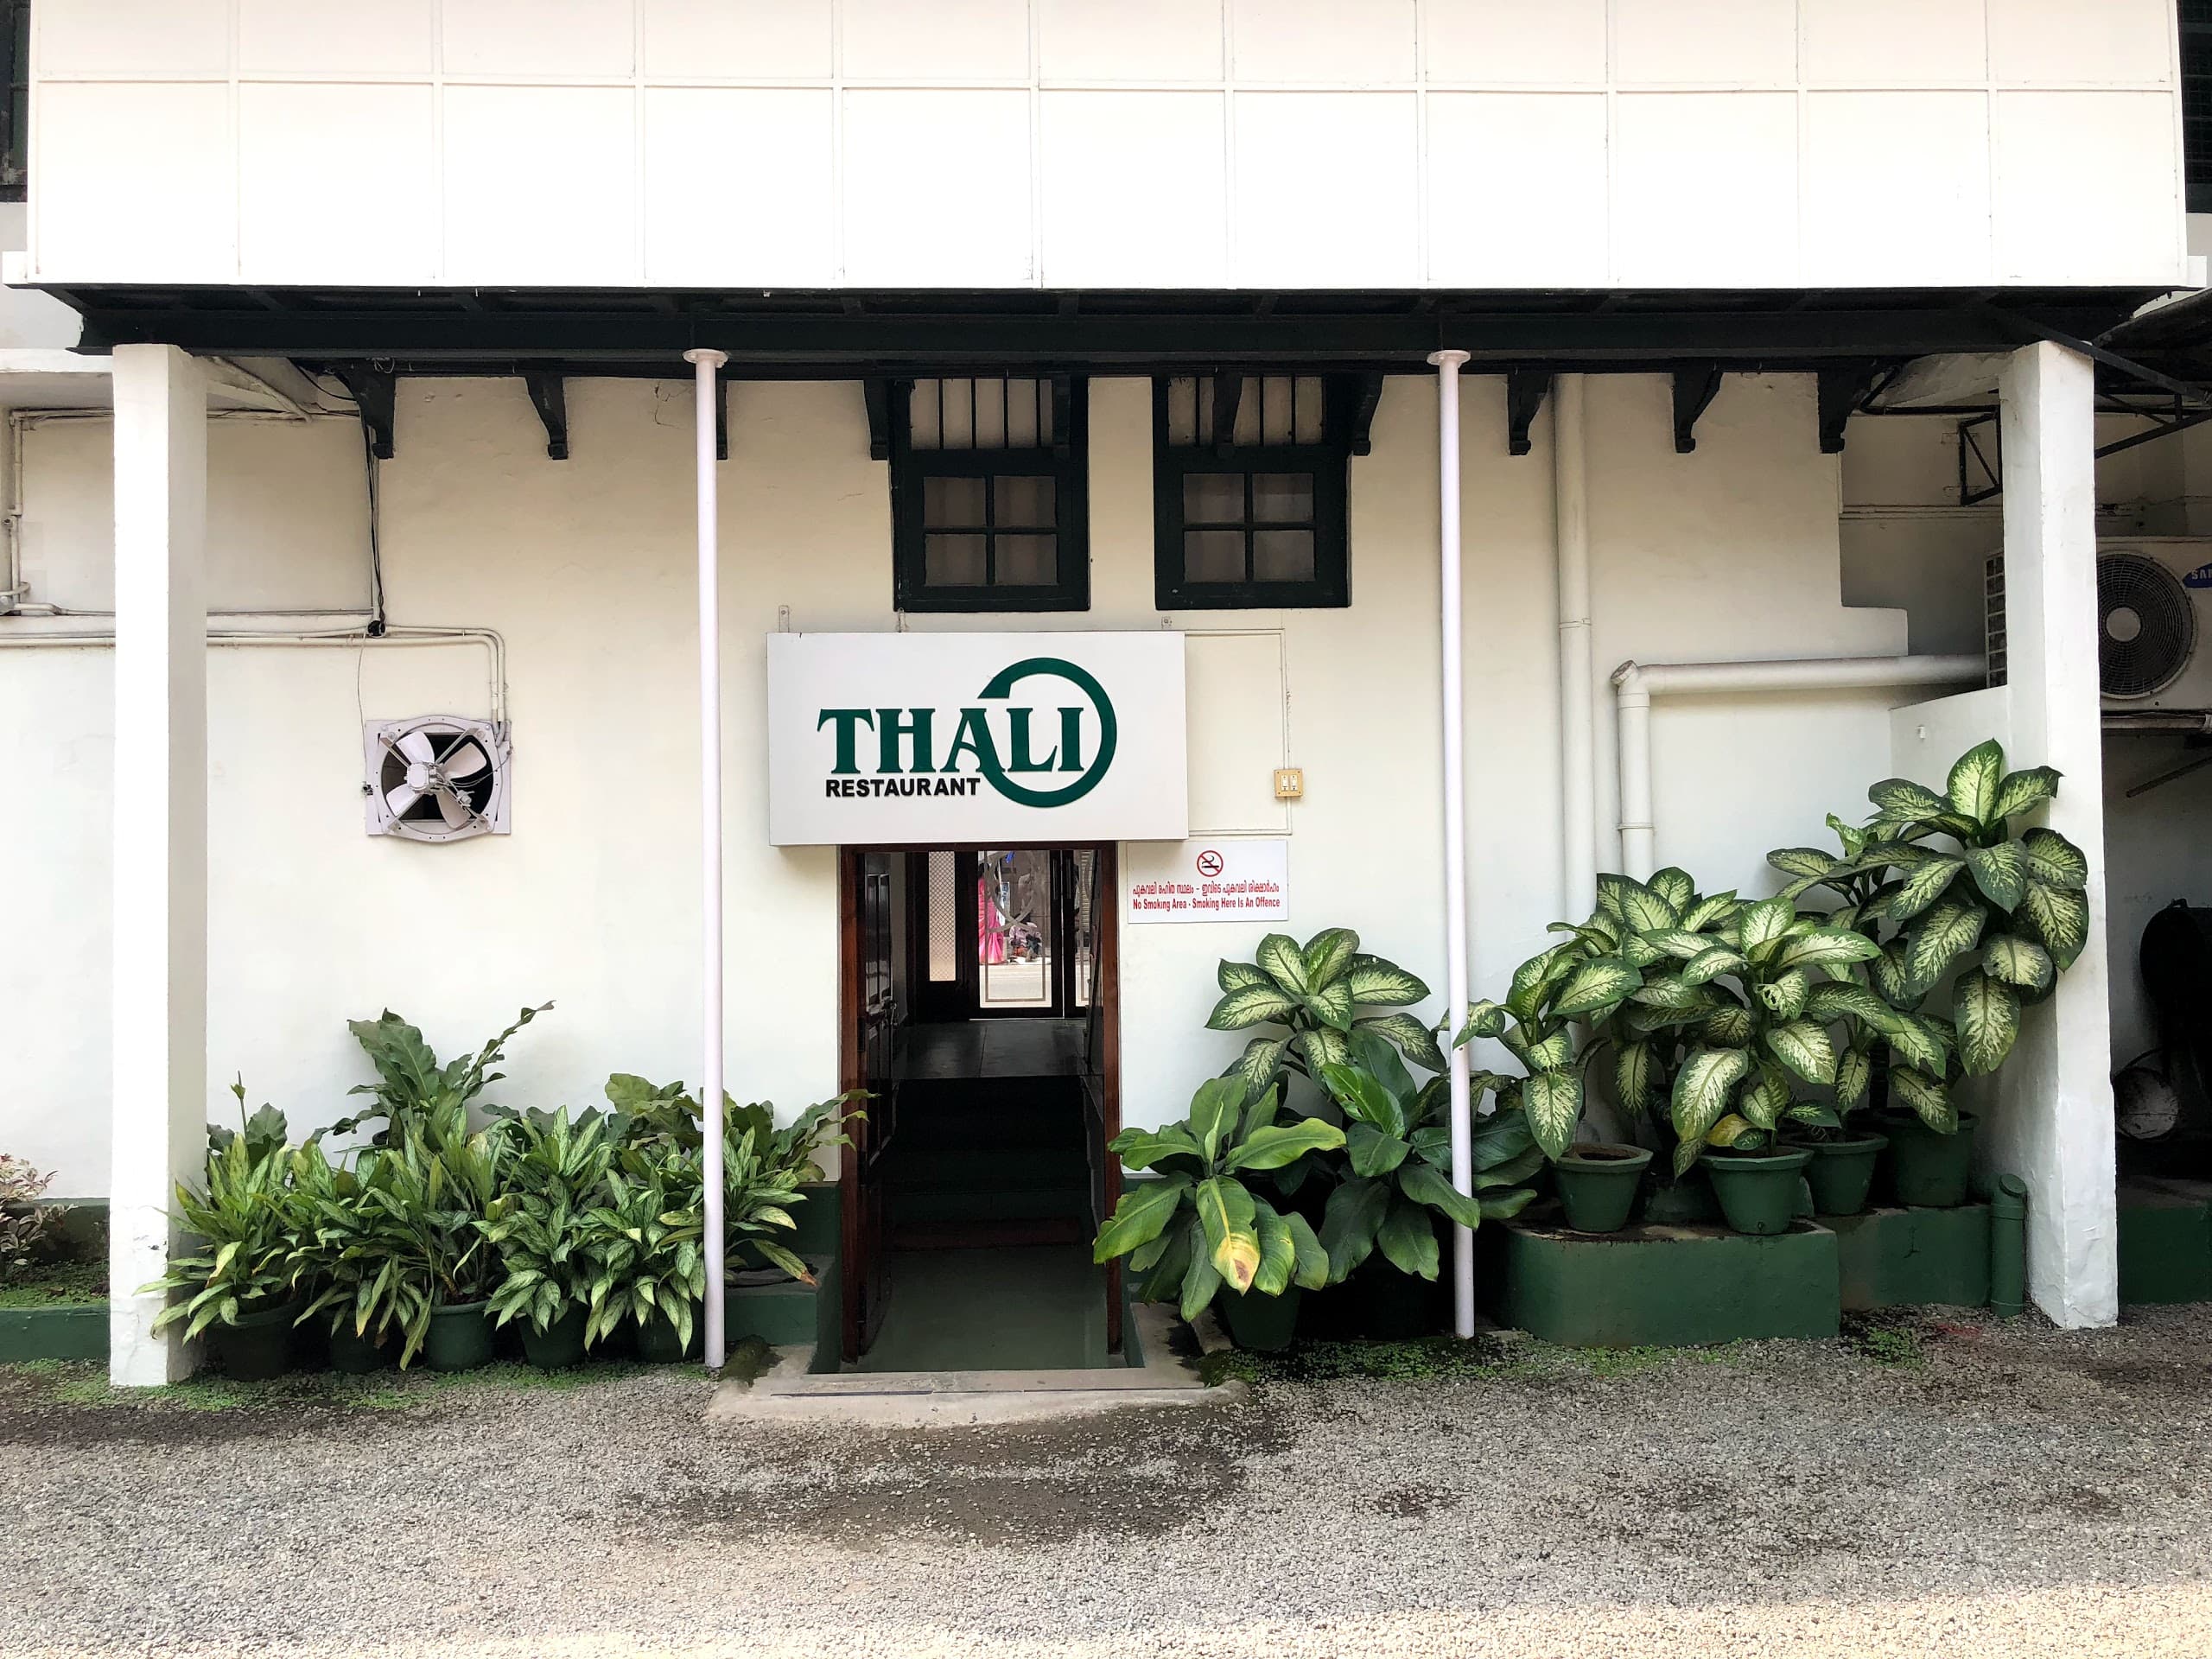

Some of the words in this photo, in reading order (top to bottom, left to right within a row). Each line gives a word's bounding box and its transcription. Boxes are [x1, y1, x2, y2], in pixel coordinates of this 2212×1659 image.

[817, 707, 1085, 774] THALI
[825, 778, 981, 798] RESTAURANT
[1133, 899, 1142, 910] No
[1143, 898, 1171, 912] Smoking
[1172, 898, 1187, 909] Area
[1192, 897, 1219, 911] Smoking
[1221, 897, 1236, 908] Here
[1237, 897, 1244, 908] Is
[1245, 896, 1255, 907] An
[1255, 895, 1281, 907] Offence
